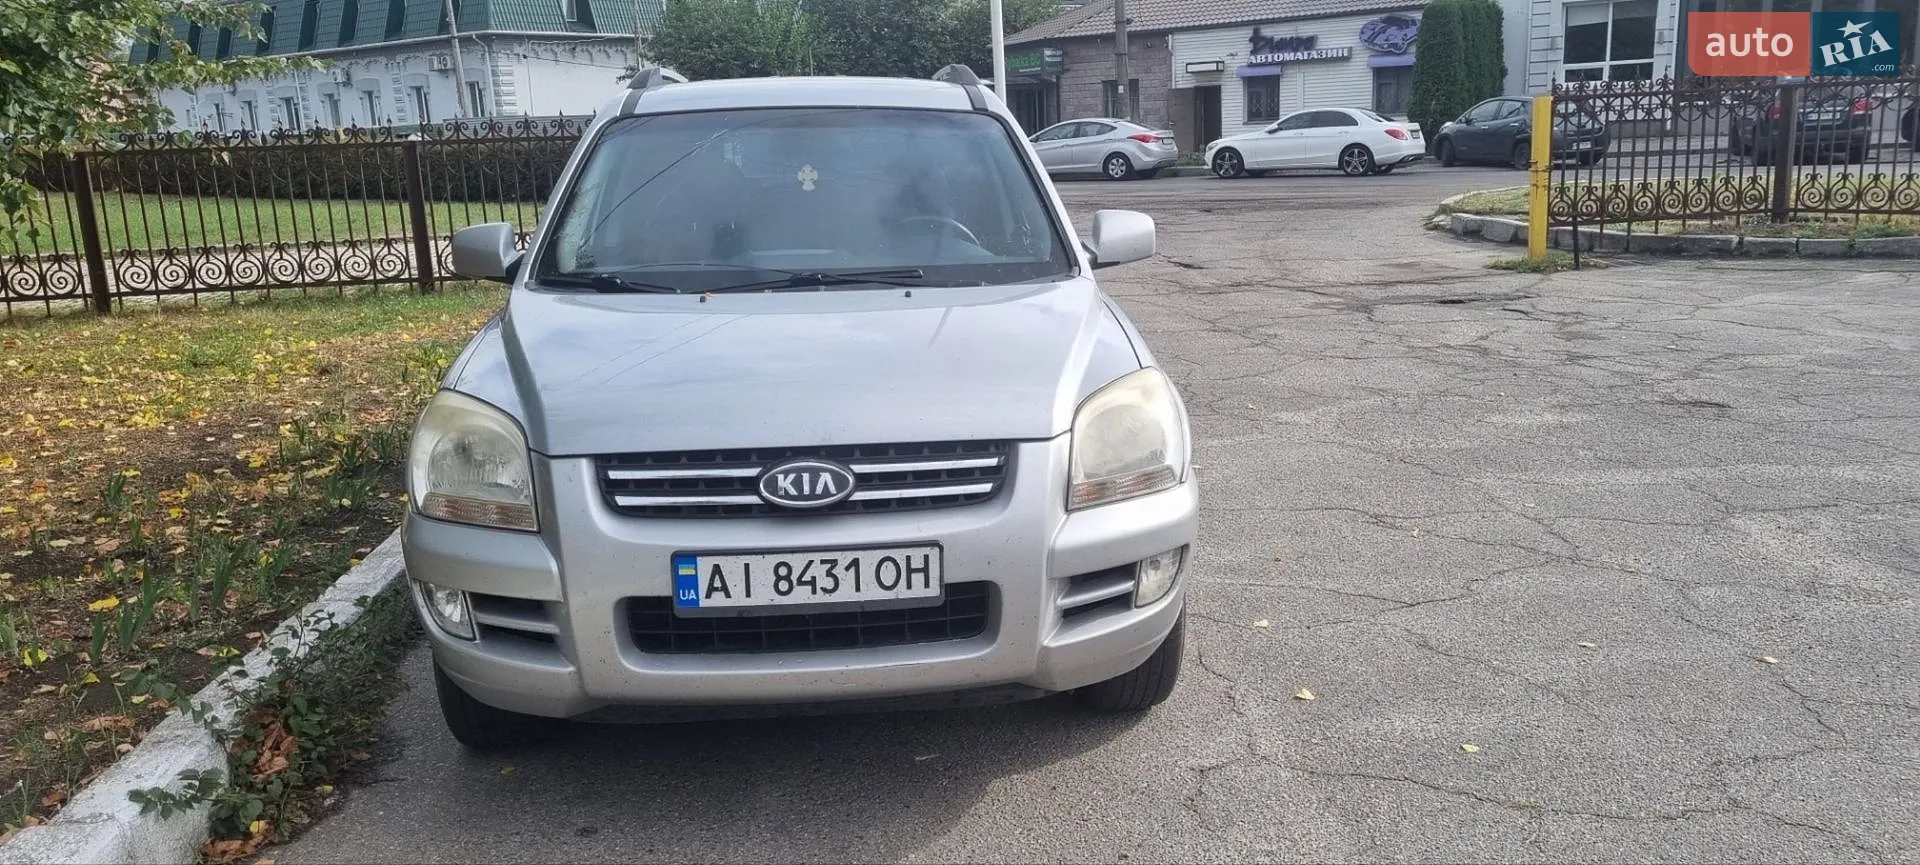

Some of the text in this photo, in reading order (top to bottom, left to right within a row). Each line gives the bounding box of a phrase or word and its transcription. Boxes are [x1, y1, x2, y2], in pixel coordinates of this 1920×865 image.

[1247, 48, 1348, 64] АВТОМАГАЗИН
[776, 472, 837, 496] KIA
[705, 554, 930, 599] AI 8431 OH
[679, 589, 697, 600] UA
